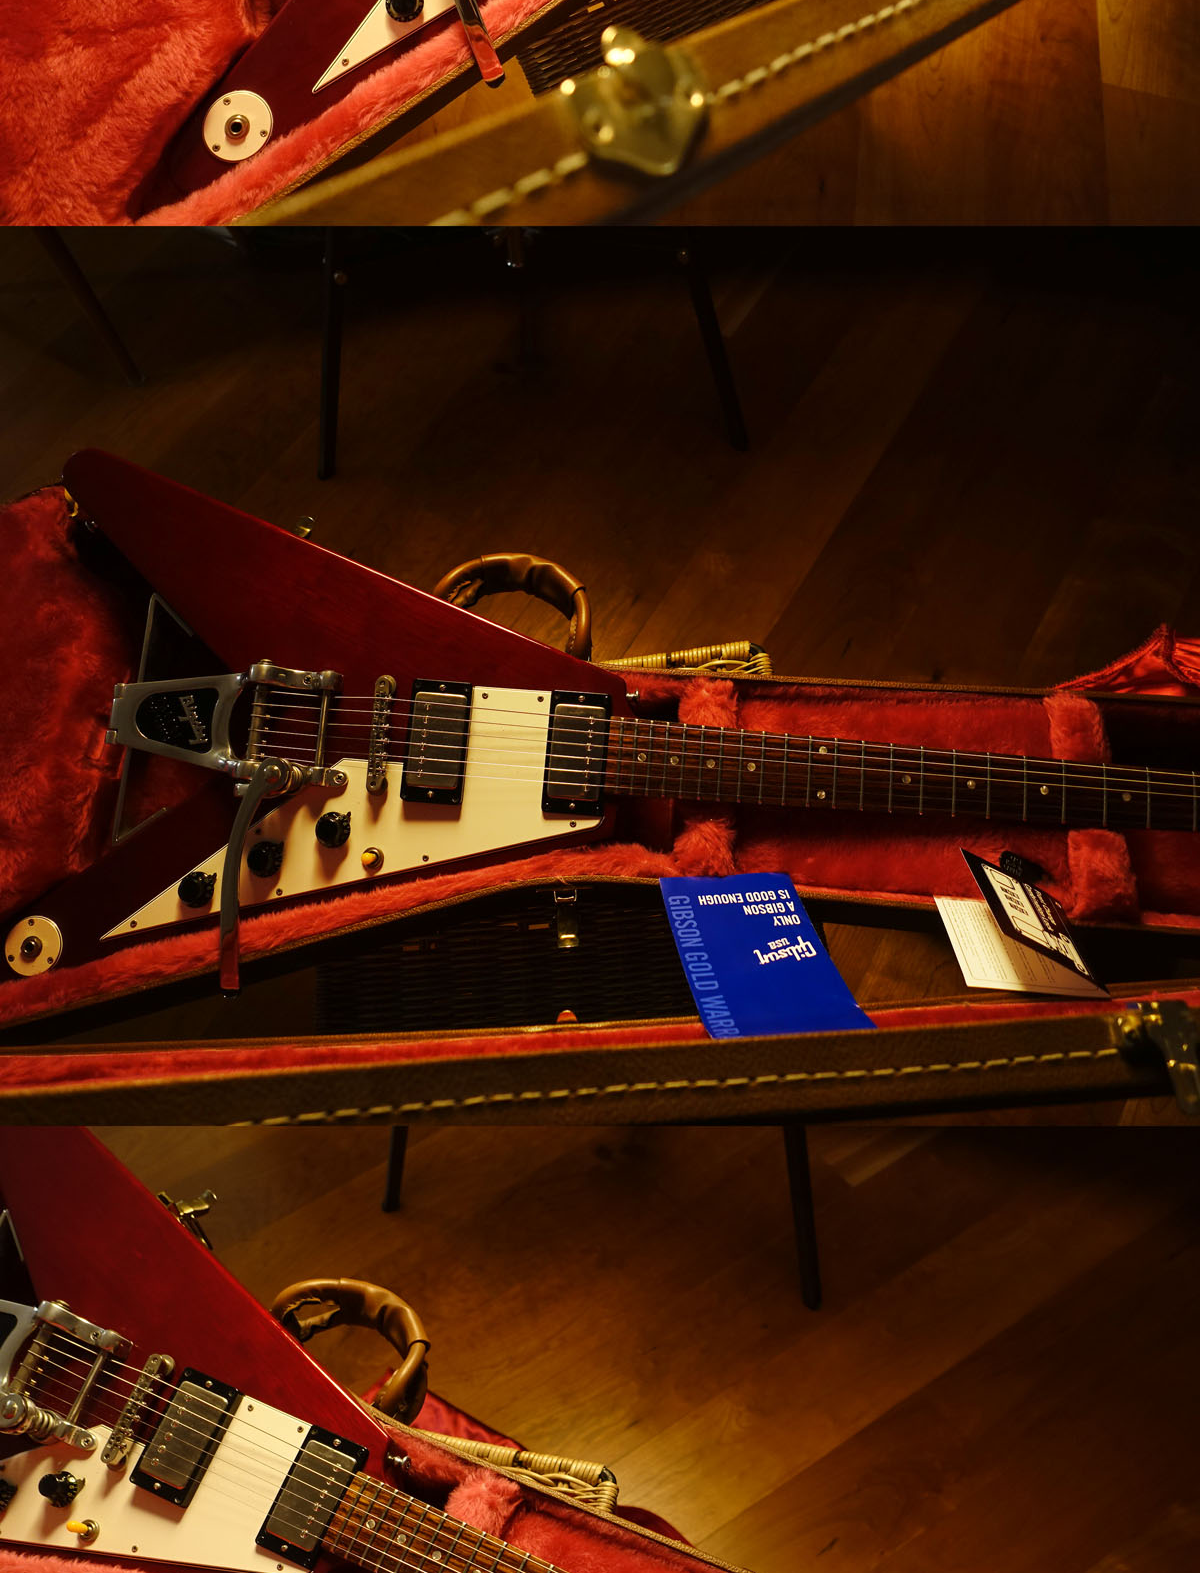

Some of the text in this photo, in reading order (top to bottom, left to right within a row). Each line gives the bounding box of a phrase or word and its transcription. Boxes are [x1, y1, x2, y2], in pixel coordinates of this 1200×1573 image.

[697, 889, 791, 906] IS GOOD ENOUGH
[742, 901, 795, 916] A GIBSON
[668, 894, 704, 948] GIBSON
[772, 914, 801, 927] ONLY
[753, 935, 817, 965] Gibson
[684, 951, 719, 991] GOLD
